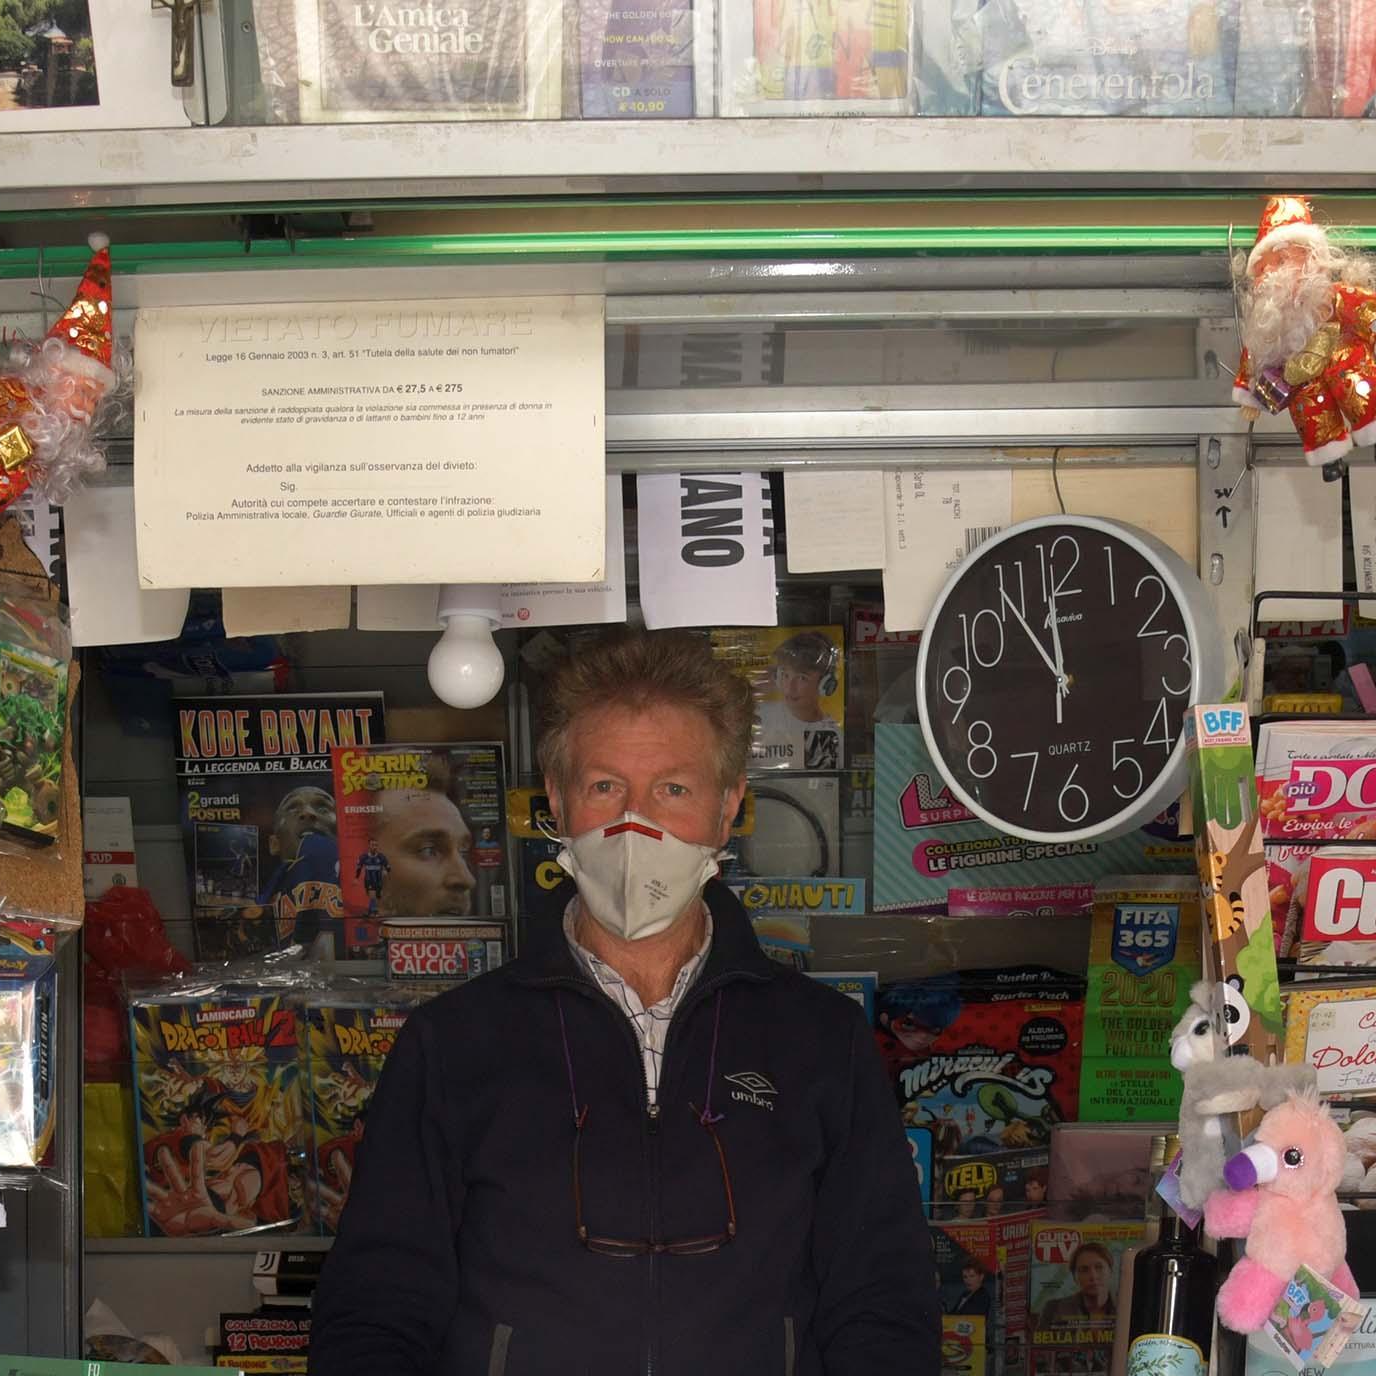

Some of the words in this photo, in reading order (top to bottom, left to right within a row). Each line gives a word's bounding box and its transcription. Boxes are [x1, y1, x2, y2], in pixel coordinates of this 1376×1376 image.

[246, 462, 283, 473] Addetto
[286, 463, 302, 472] alla
[305, 462, 347, 474] vigilanza
[350, 461, 423, 472] sull'osservanza
[426, 461, 440, 470] del
[443, 461, 478, 470] divieto:
[280, 482, 298, 493] Sig.
[1204, 711, 1242, 734] BFF
[180, 709, 251, 758] KOBE
[261, 708, 372, 755] BRYANT
[1048, 741, 1091, 756] QUARTZ
[929, 855, 945, 871] LE
[949, 847, 1020, 869] FIGURINE
[1026, 841, 1099, 864] SPECIALI
[1121, 910, 1171, 927] FIFA
[1119, 930, 1169, 948] 365
[390, 943, 465, 960] SCUOLA
[391, 958, 457, 975] CALCIO
